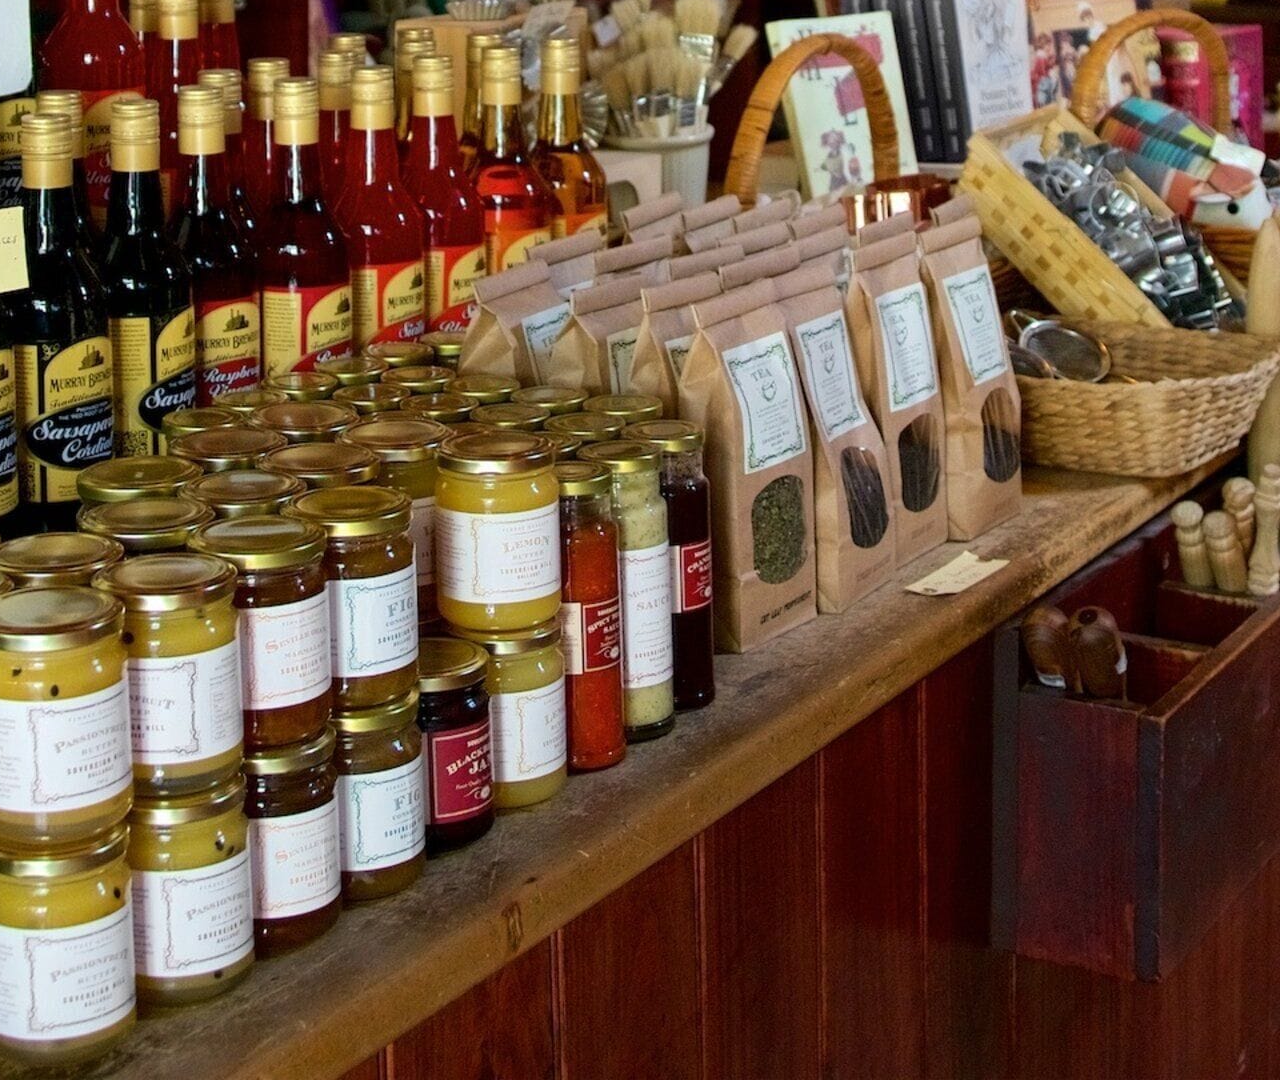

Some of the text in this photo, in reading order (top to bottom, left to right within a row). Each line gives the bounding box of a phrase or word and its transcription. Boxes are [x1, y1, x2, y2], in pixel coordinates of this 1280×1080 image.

[750, 368, 772, 381] TEA
[49, 376, 86, 394] MURRAY
[502, 534, 551, 554] LEMON
[386, 596, 415, 617] FIG
[393, 788, 420, 811] FIG
